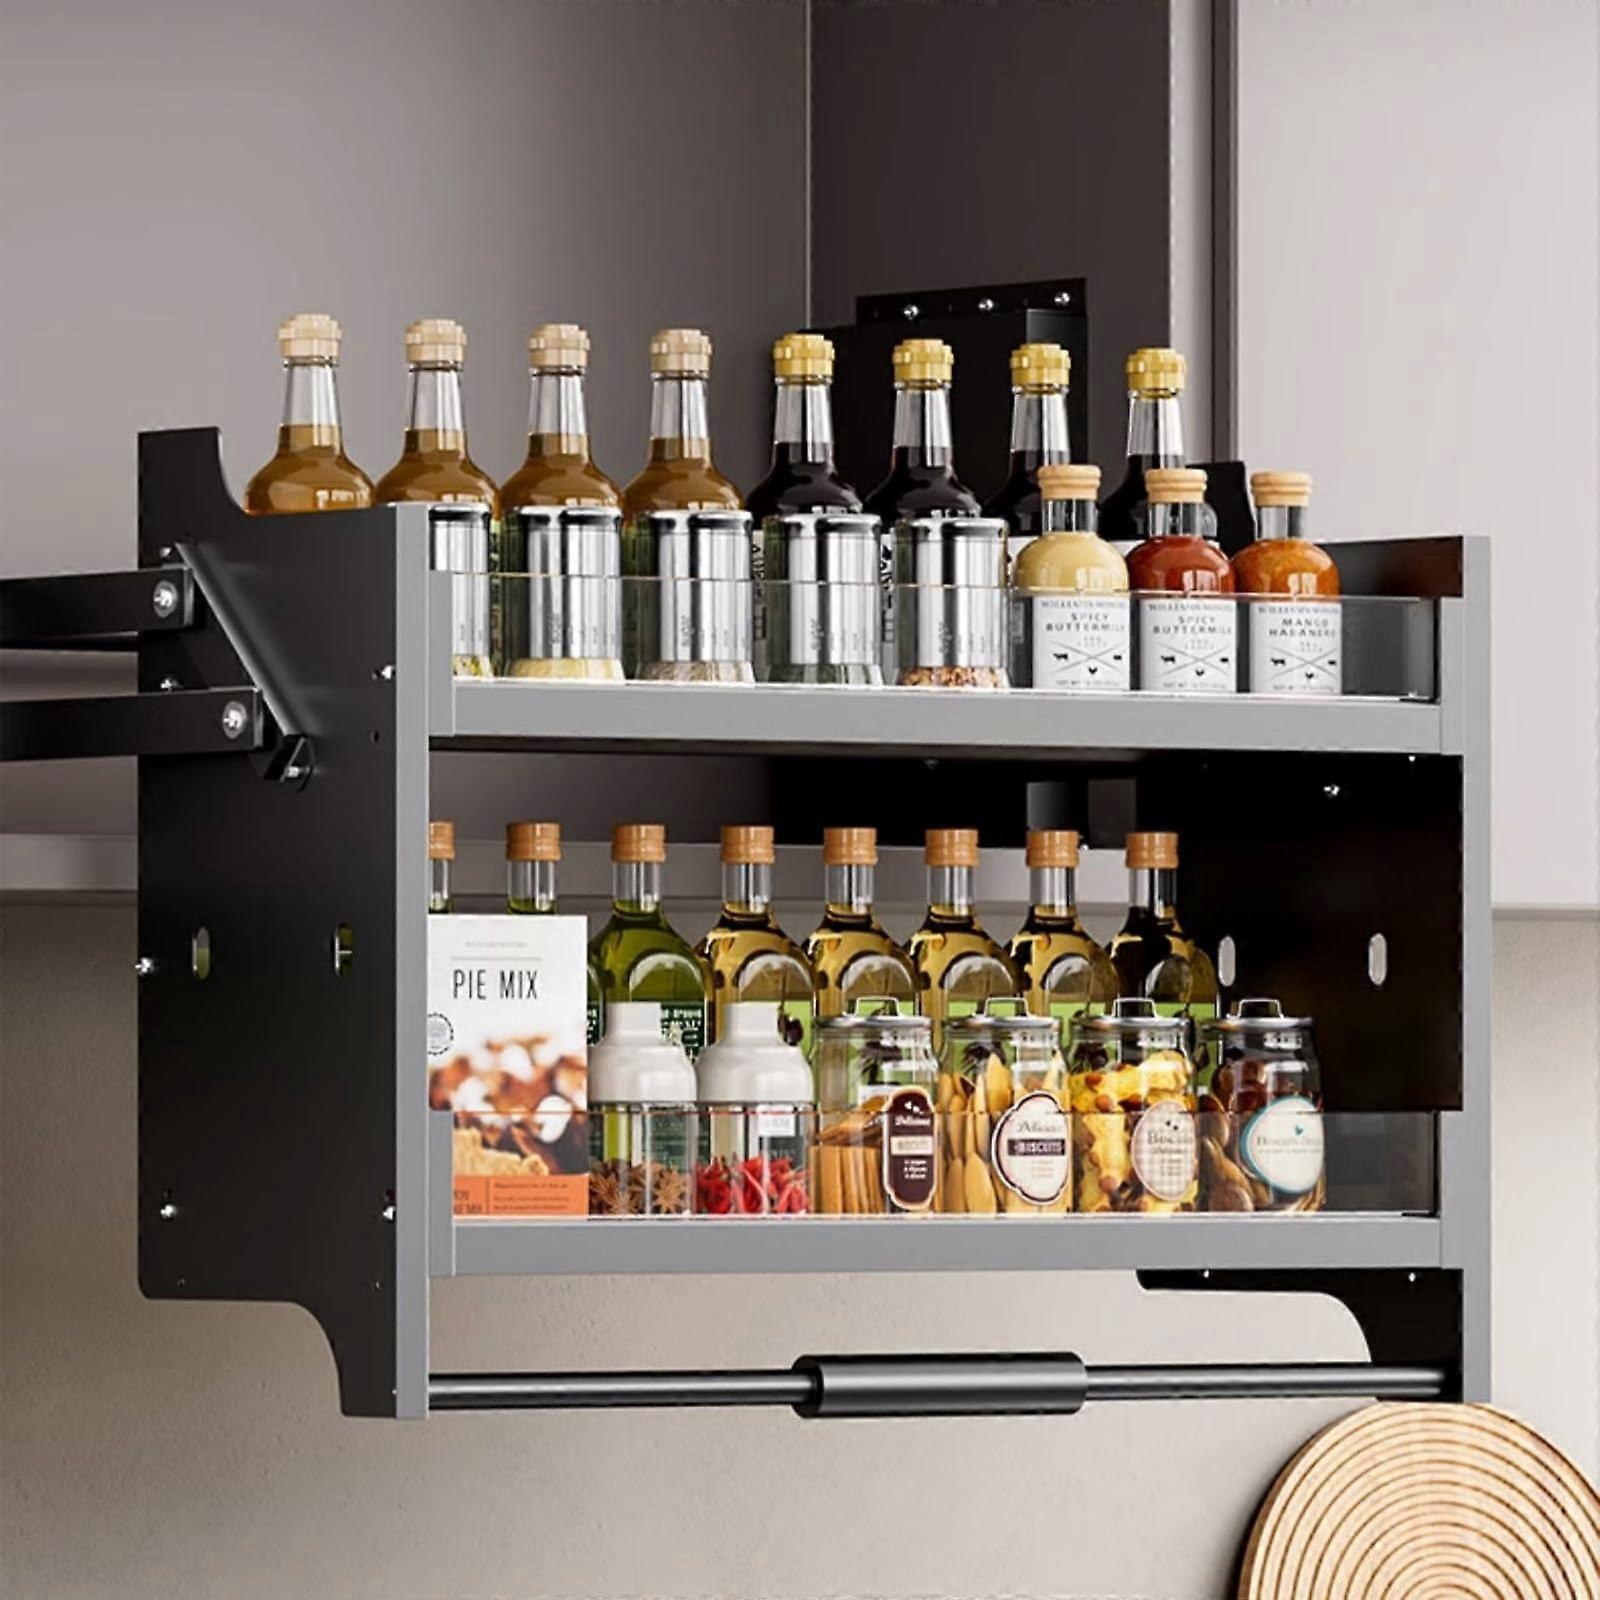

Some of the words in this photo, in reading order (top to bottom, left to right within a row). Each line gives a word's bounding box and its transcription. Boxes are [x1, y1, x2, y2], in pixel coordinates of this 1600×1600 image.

[1071, 612, 1108, 621] SPICY
[1178, 615, 1215, 624] SPICY
[1281, 618, 1329, 627] MANGO
[453, 968, 487, 1000] PIE
[500, 969, 538, 1000] MIX
